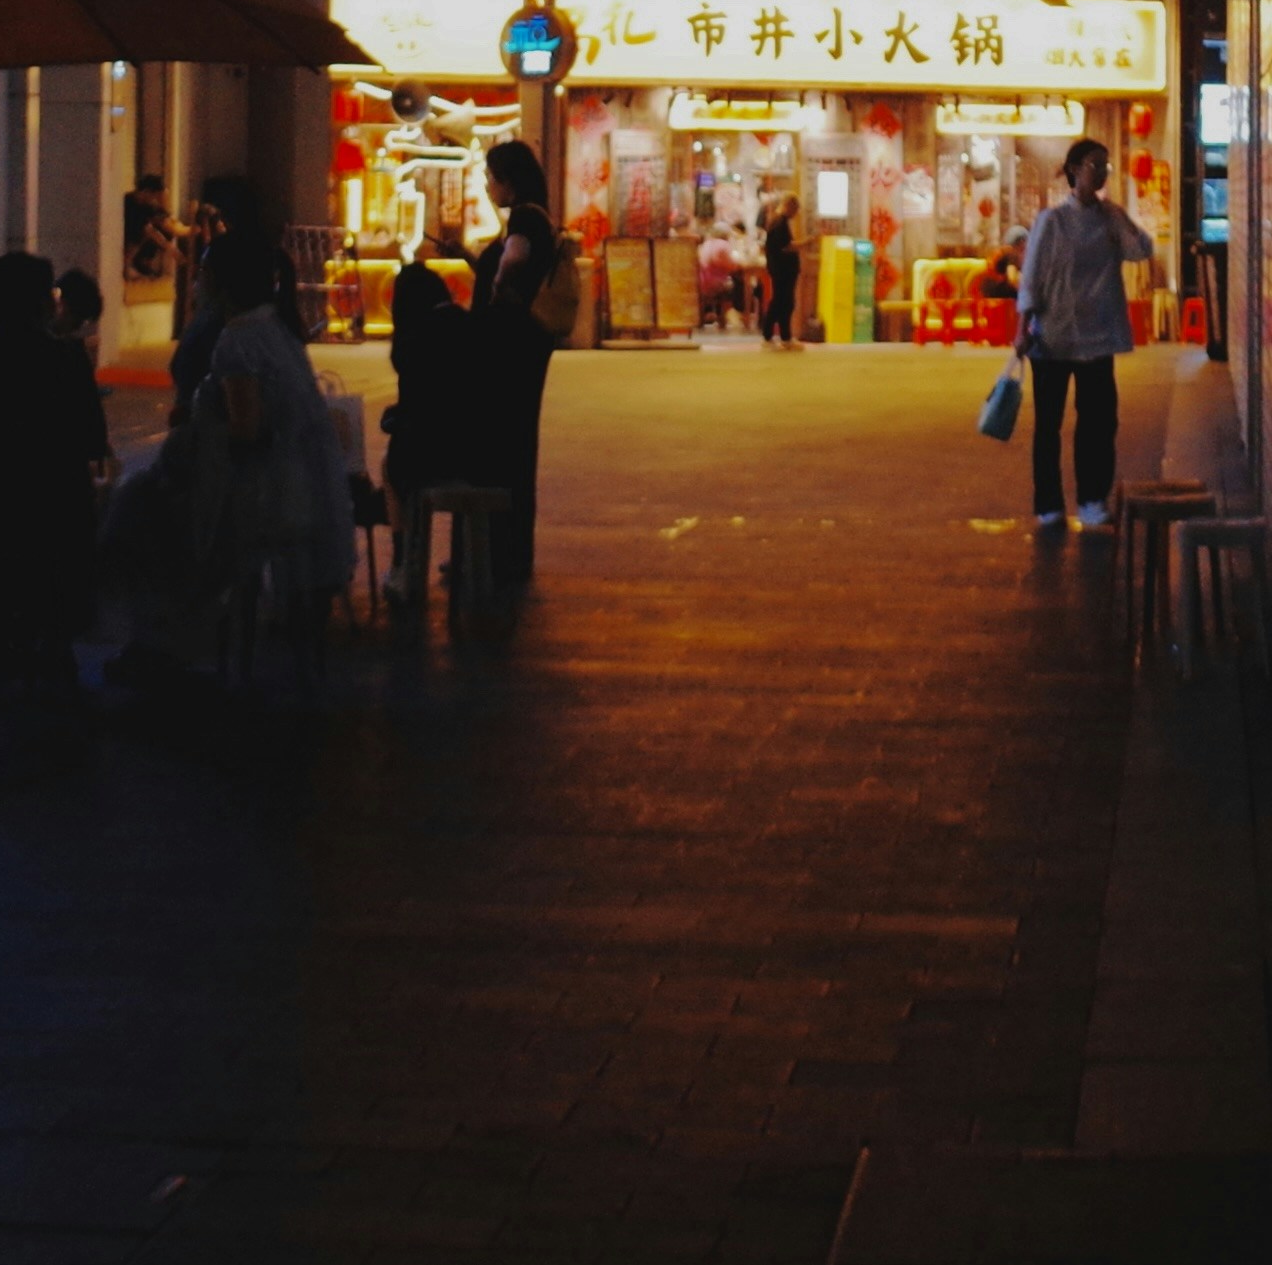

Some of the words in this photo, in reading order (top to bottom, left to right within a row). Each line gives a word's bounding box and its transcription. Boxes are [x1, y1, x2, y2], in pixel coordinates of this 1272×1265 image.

[686, 1, 1004, 67] 市井小火锅
